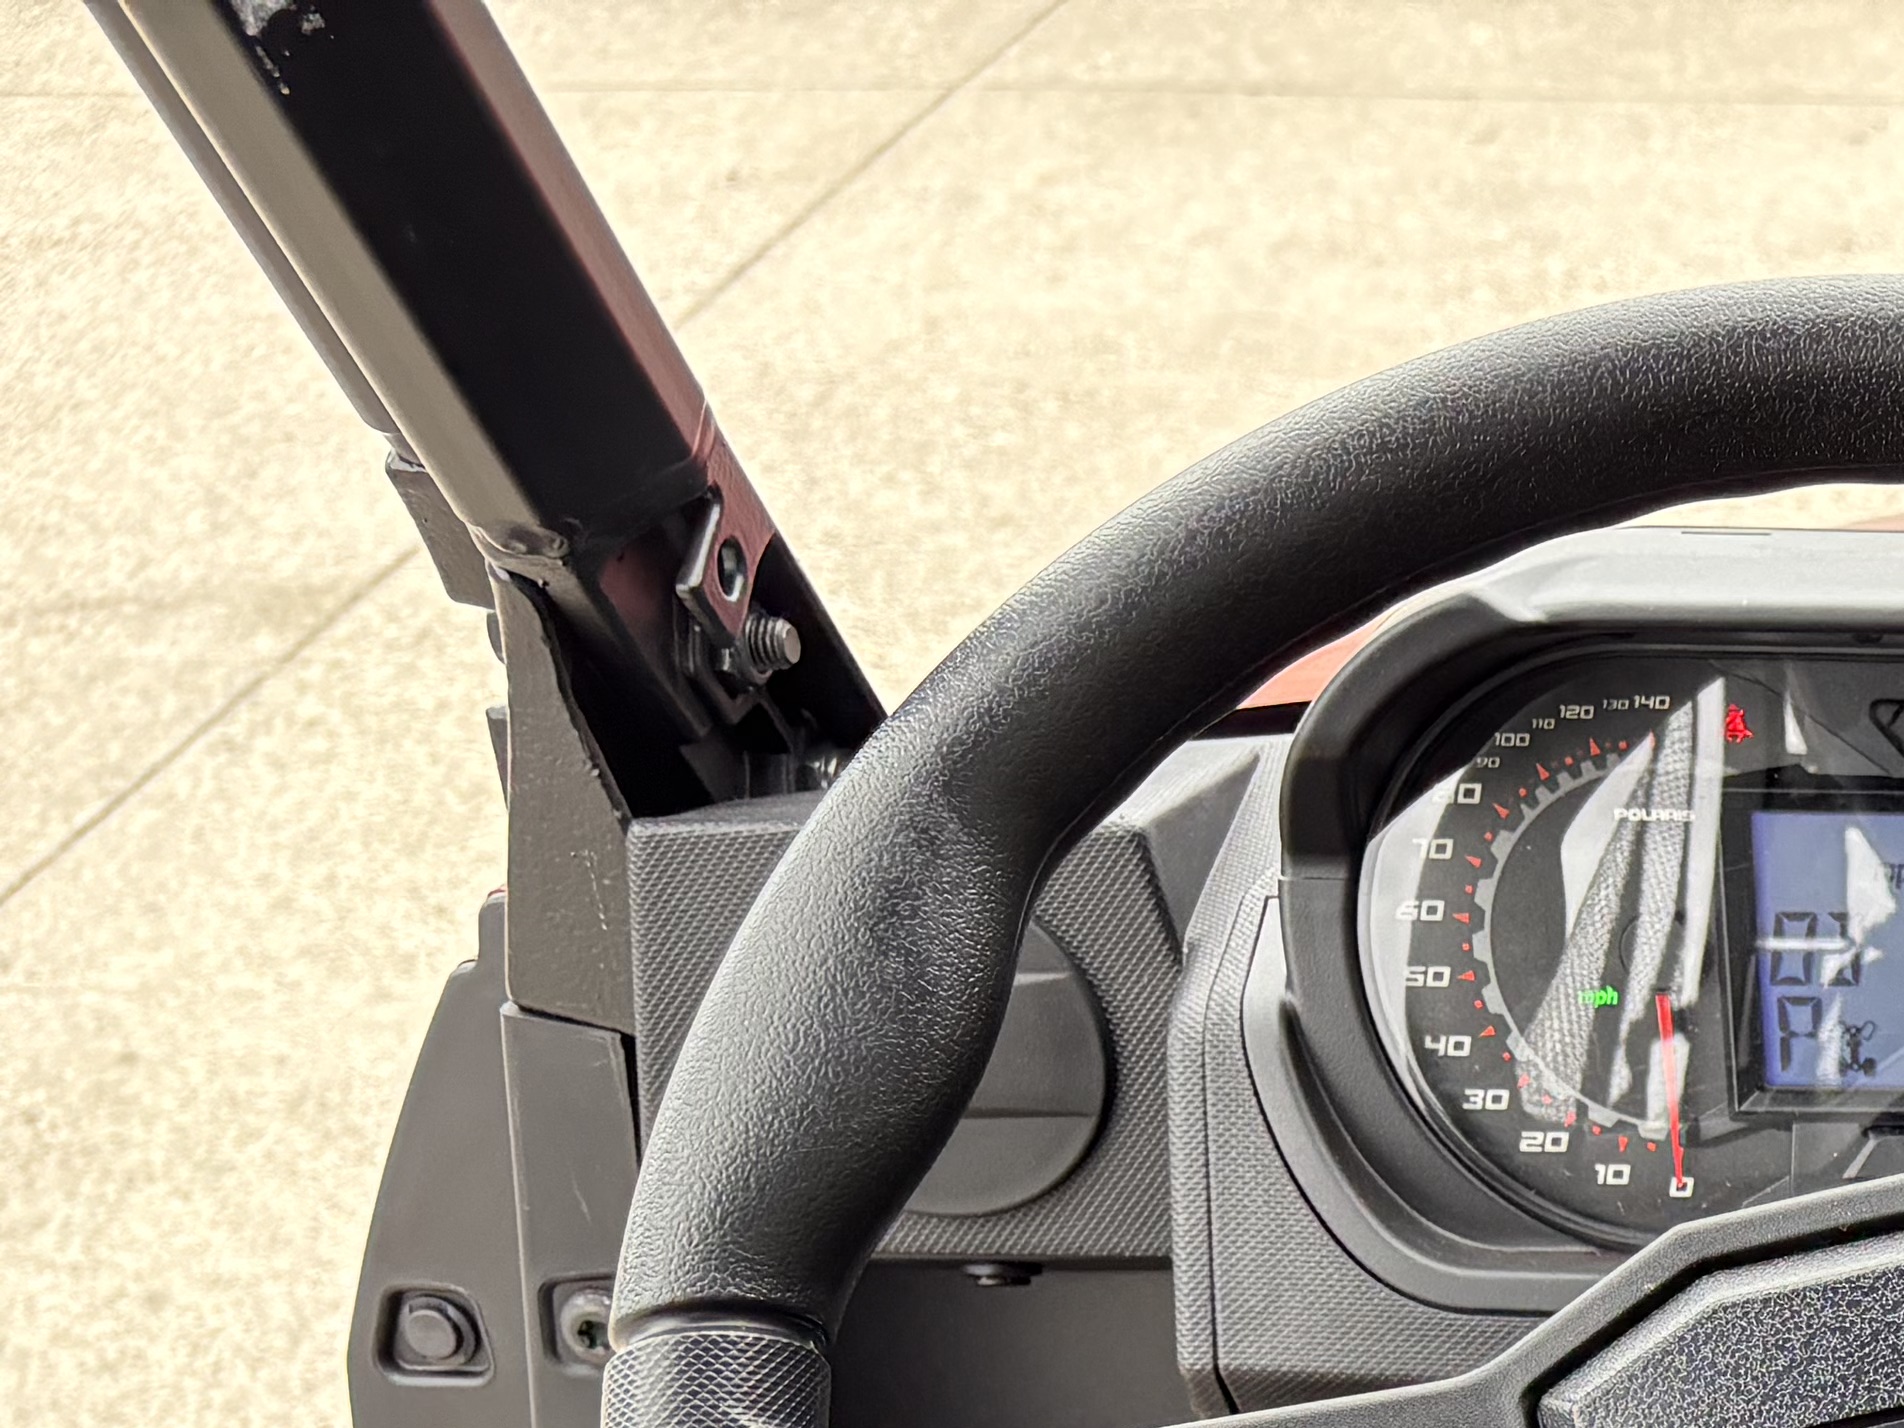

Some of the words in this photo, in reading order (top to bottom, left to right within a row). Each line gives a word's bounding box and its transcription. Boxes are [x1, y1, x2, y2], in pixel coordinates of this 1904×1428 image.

[1559, 705, 1595, 720] 120
[1602, 699, 1629, 710] 130
[1634, 695, 1670, 710] 140
[1532, 718, 1555, 730] 110
[1494, 732, 1530, 747] 100
[1476, 756, 1500, 768] 90
[1613, 807, 1696, 822] POLARIS
[1412, 838, 1453, 860] 70
[1395, 899, 1445, 921] 60
[1405, 965, 1451, 987] 50
[1577, 984, 1618, 1008] mph
[1777, 995, 1823, 1072] P
[1424, 1034, 1472, 1057] 40
[1462, 1088, 1510, 1111] 30
[1519, 1130, 1569, 1153] 20
[1594, 1163, 1631, 1185] 10
[1669, 1176, 1694, 1197] 0
